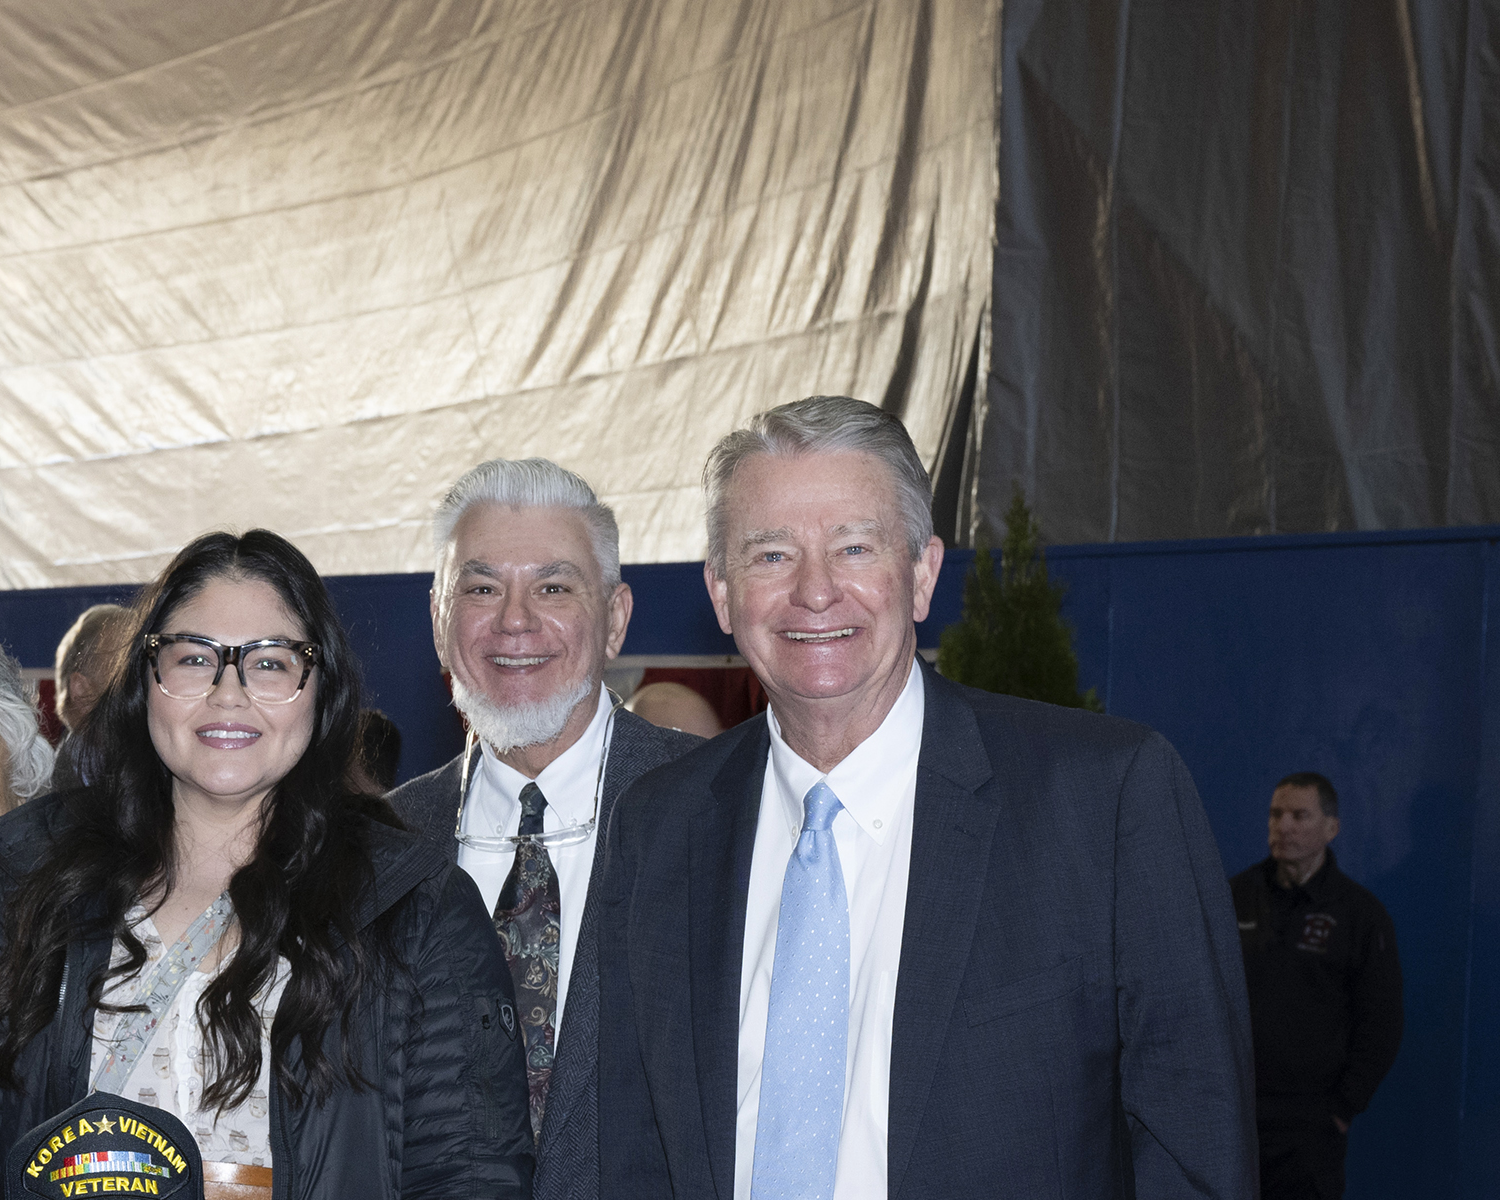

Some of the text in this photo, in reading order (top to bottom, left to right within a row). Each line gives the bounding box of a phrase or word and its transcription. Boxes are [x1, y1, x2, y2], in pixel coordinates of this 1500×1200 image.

[26, 1116, 188, 1178] KOREA VIETNAM
[59, 1177, 159, 1198] VETERAN
